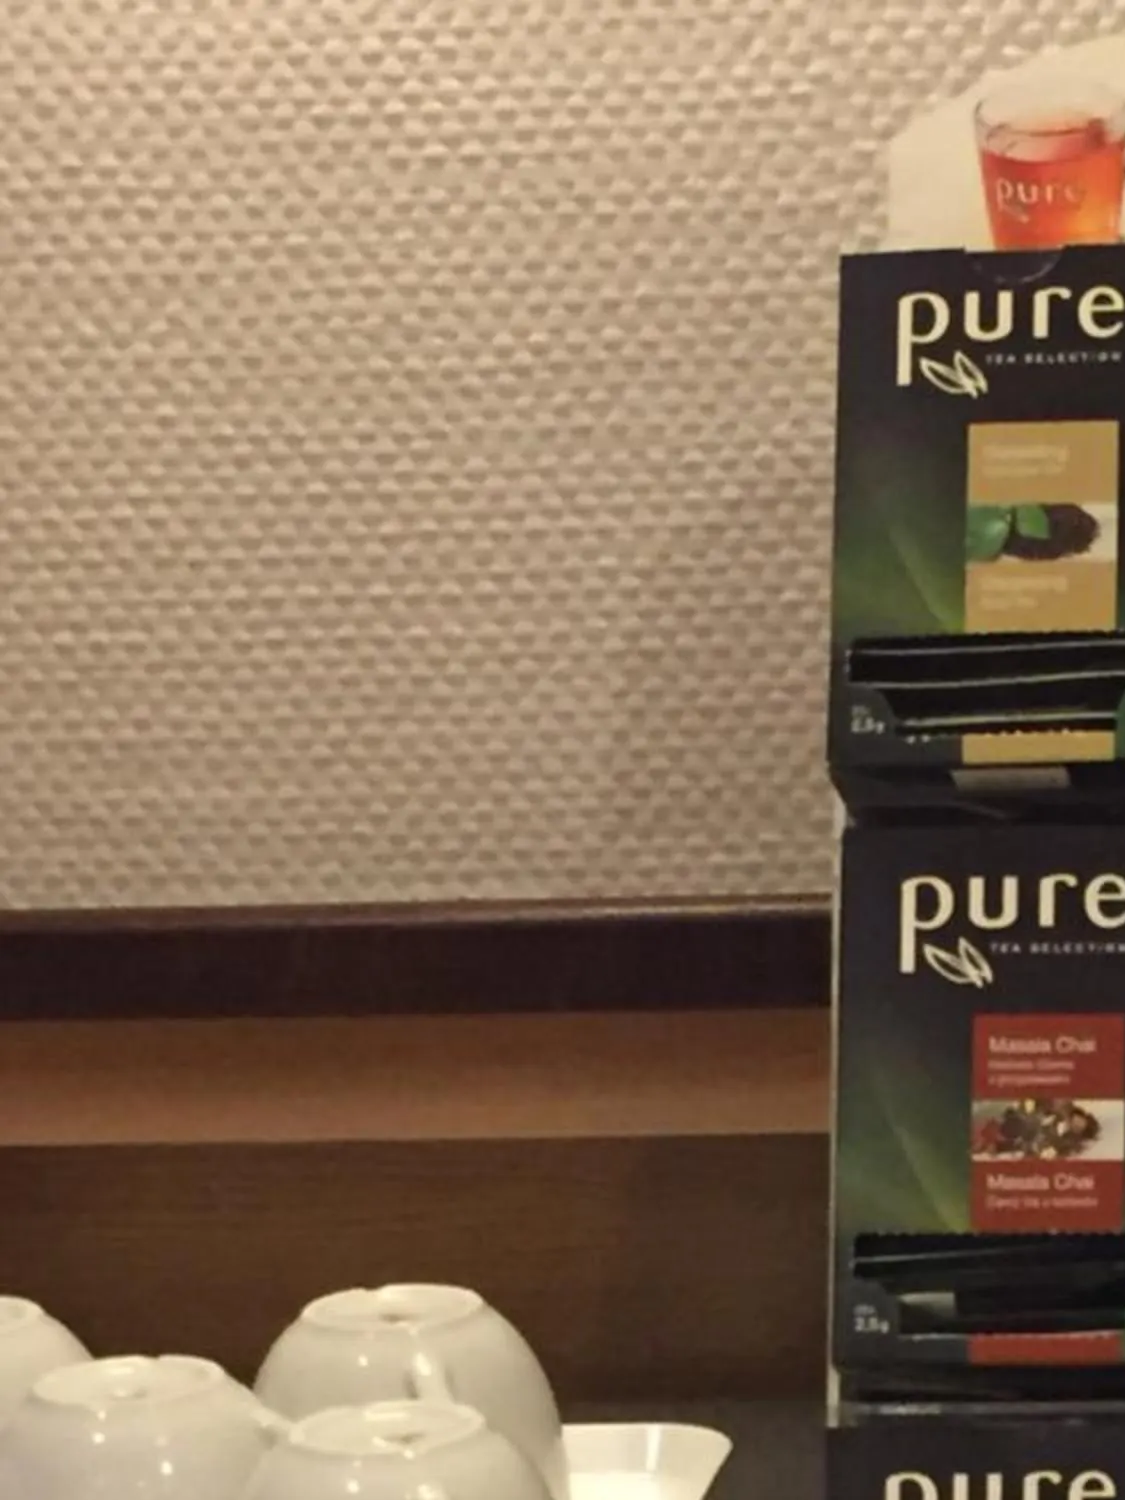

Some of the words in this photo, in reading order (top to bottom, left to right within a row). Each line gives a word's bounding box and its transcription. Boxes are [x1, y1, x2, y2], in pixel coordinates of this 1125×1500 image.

[897, 285, 1125, 386] pure
[986, 353, 1016, 365] TEA
[1024, 351, 1122, 364] SELECTION
[990, 943, 1021, 955] TEA
